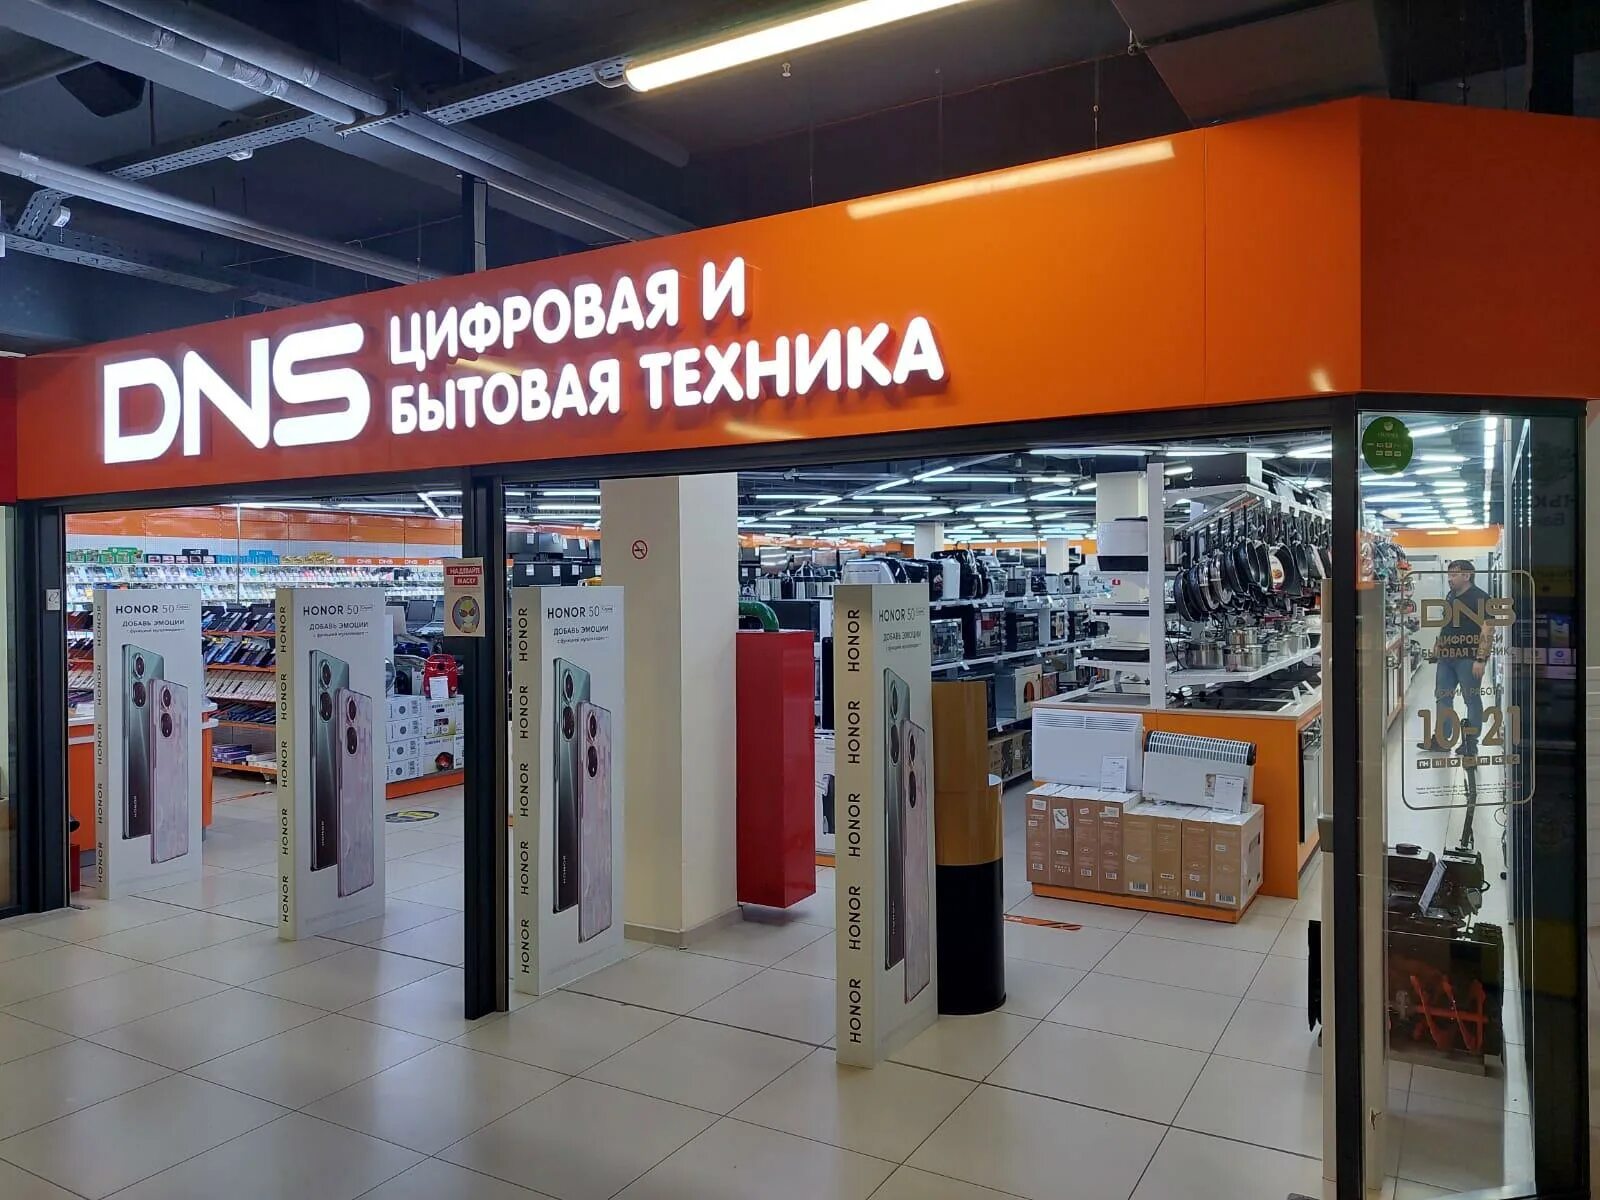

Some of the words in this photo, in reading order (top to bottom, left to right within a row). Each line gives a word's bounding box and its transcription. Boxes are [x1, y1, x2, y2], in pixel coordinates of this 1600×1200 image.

[390, 269, 679, 371] ЦИФРОВАЯ
[702, 257, 745, 320] И
[103, 323, 371, 464] DNS
[391, 358, 620, 435] БЫТОВАЯ
[639, 317, 944, 410] ТЕХНИКА
[449, 566, 481, 575] НАДЕВАЙТЕ
[457, 577, 476, 585] МАСКУ
[115, 604, 159, 614] HONOR
[162, 604, 175, 614] 50
[279, 606, 287, 653] HONOR
[303, 605, 344, 616] HONOR
[346, 604, 359, 615] 50
[338, 621, 369, 629] ЭМОЦИИ
[547, 606, 586, 619] HONOR
[588, 605, 600, 617] 50
[553, 626, 580, 636] ДОБАВЬ
[580, 624, 609, 635] ЭМОЦИИ
[879, 608, 906, 622] HONOR
[907, 607, 916, 620] 50
[1420, 598, 1517, 627] DNS
[518, 607, 528, 662] HONOR
[847, 609, 860, 672] HONOR
[1421, 646, 1469, 658] БЫТОВАЯ
[280, 673, 288, 720] HONOR
[519, 685, 529, 739] HONOR
[847, 700, 861, 764] HONOR
[1417, 705, 1520, 750] 10-21
[519, 763, 529, 817] HONOR
[847, 793, 861, 857] HONOR
[520, 841, 529, 896] HONOR
[848, 886, 861, 951] HONOR
[520, 919, 530, 974] HONOR
[848, 978, 862, 1044] HONOR
